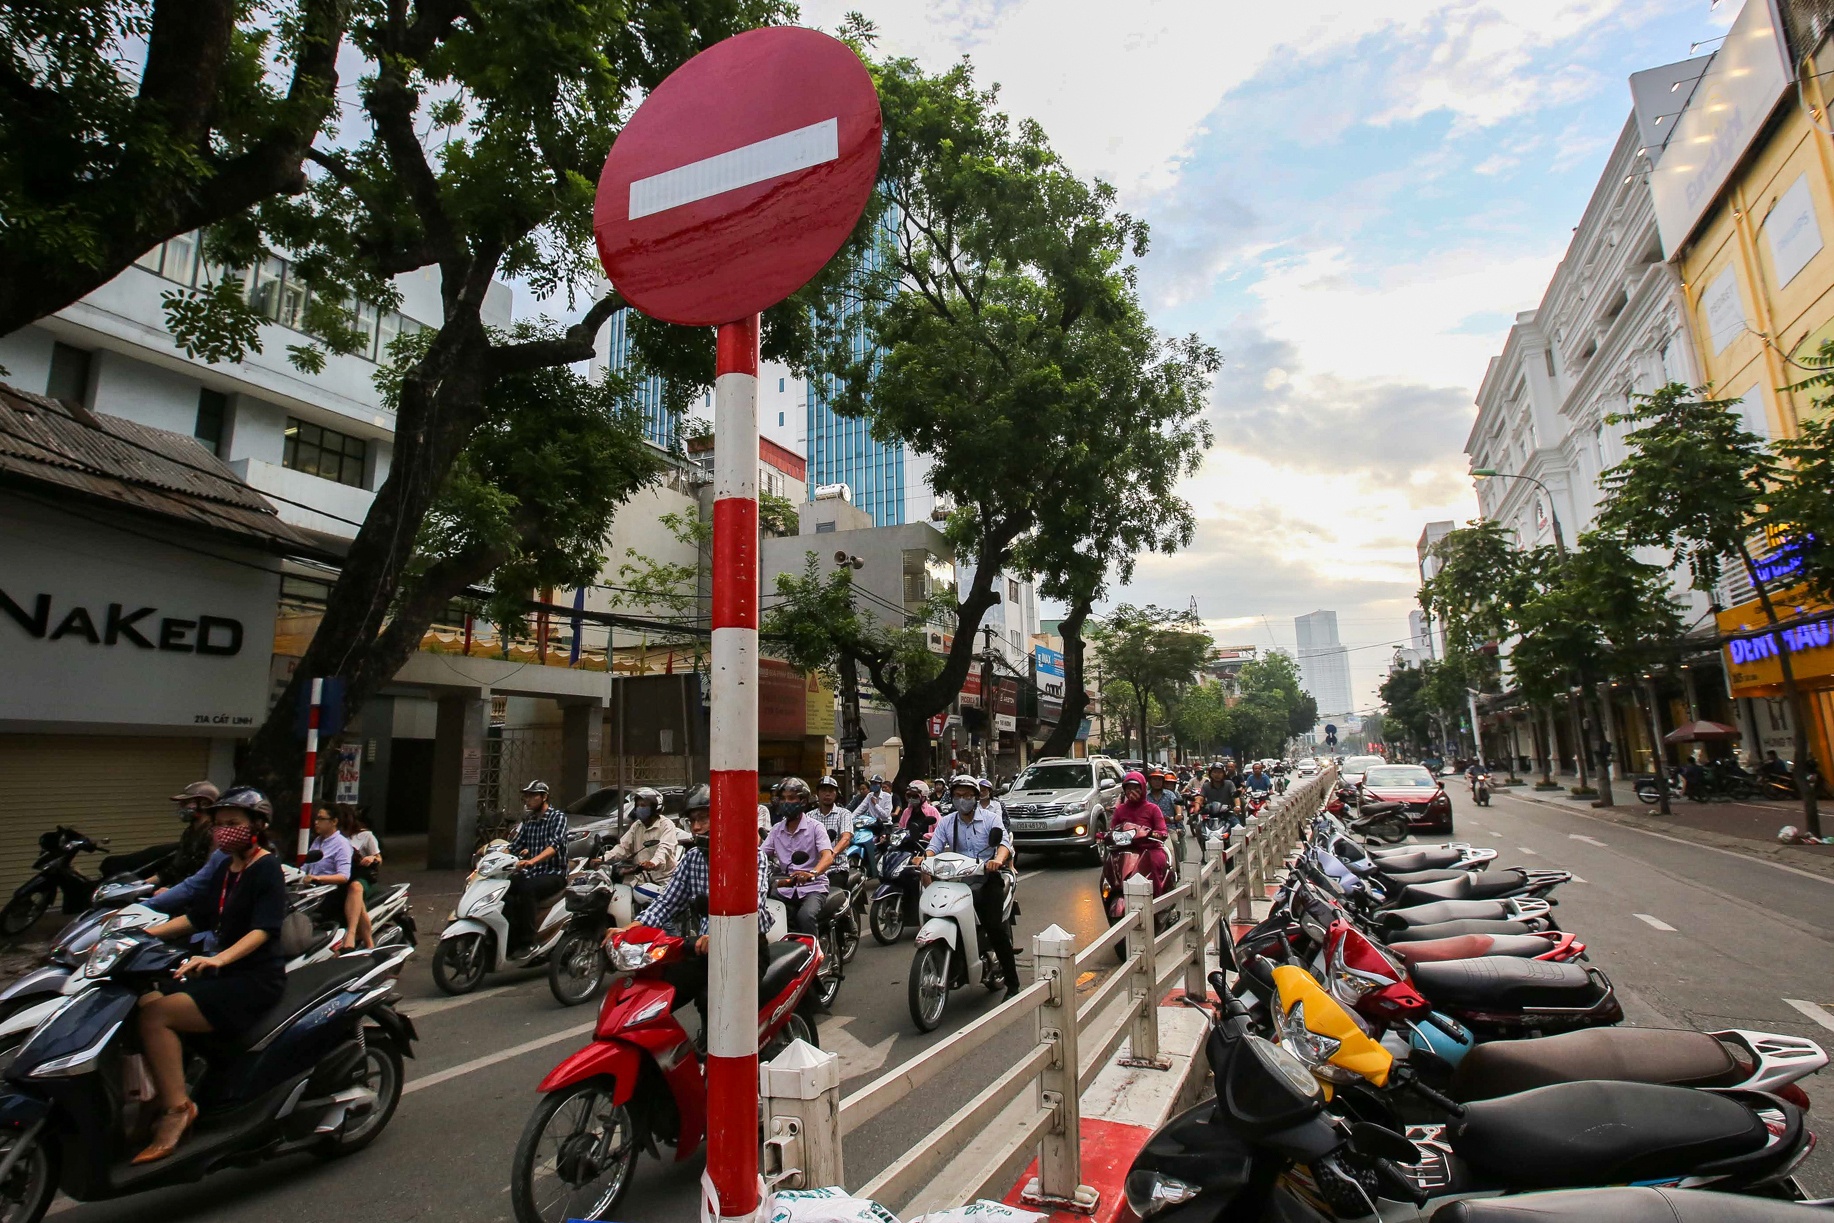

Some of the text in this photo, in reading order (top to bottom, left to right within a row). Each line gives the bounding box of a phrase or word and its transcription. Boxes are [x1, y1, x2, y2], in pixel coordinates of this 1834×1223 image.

[0, 590, 244, 656] NAKED
[194, 715, 209, 724] 21A
[232, 717, 253, 725] LINH
